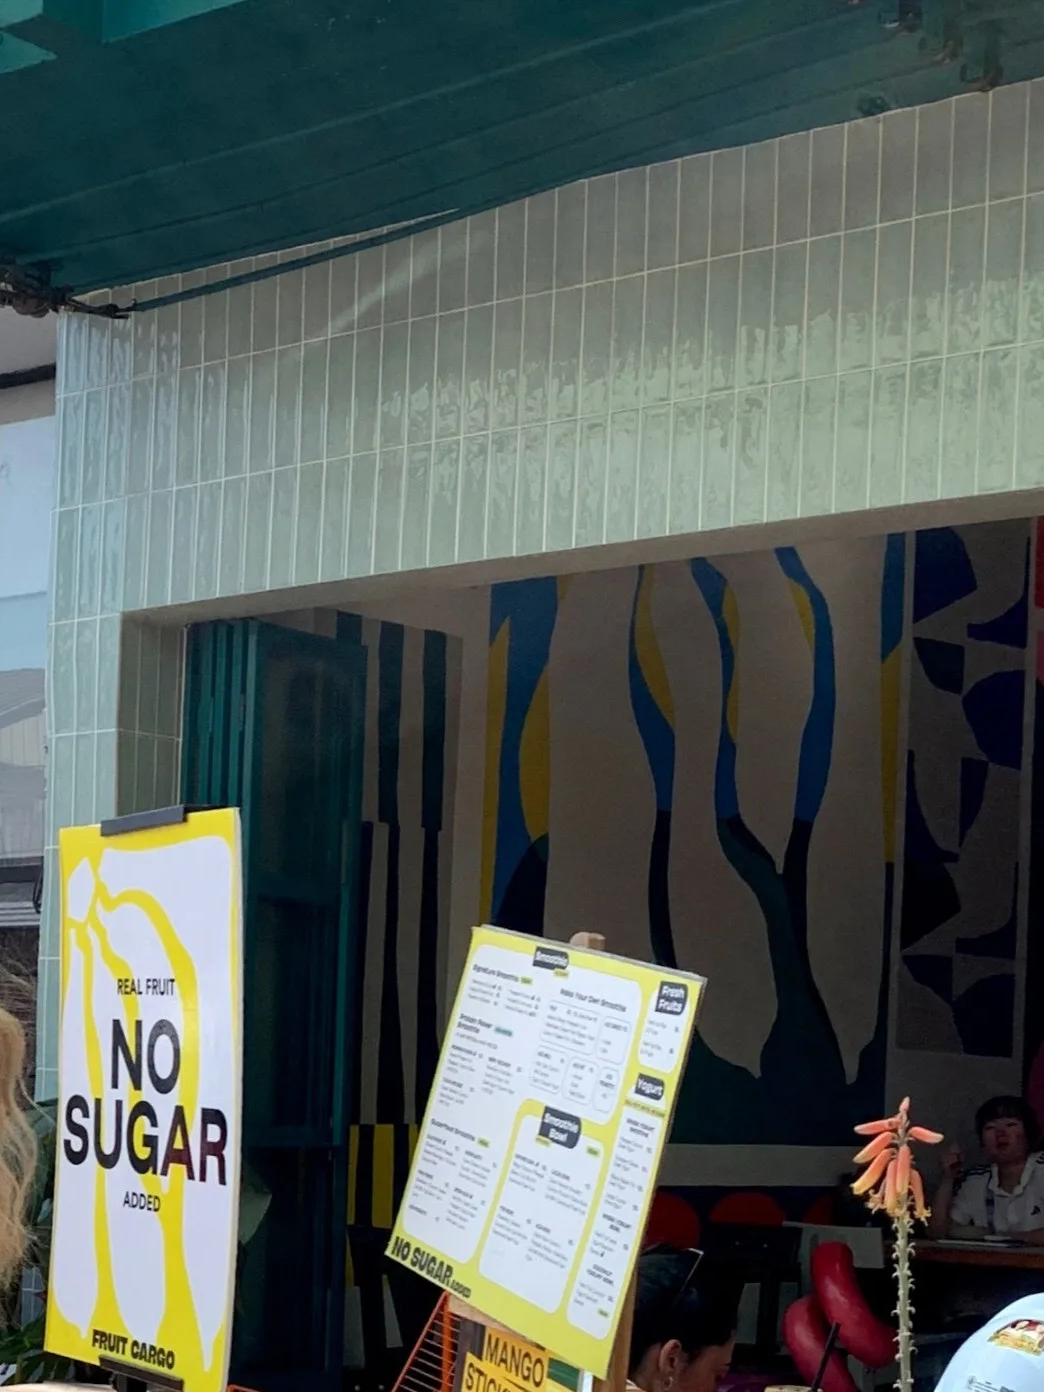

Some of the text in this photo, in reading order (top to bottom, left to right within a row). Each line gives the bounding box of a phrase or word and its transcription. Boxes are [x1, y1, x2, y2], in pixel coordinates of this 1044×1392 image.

[116, 978, 176, 997] REAL FRUIT
[661, 984, 685, 999] Fresh
[659, 998, 683, 1013] Fruits
[111, 1018, 181, 1095] NO
[637, 1077, 664, 1097] Yogurt
[544, 1112, 579, 1134] Smoothie
[63, 1094, 228, 1186] SUGAR
[122, 1190, 161, 1213] ADDED
[391, 1236, 411, 1261] NO
[410, 1246, 453, 1287] SUGAR
[92, 1328, 175, 1370] FRUIT CARGO
[484, 1333, 545, 1388] MANGO
